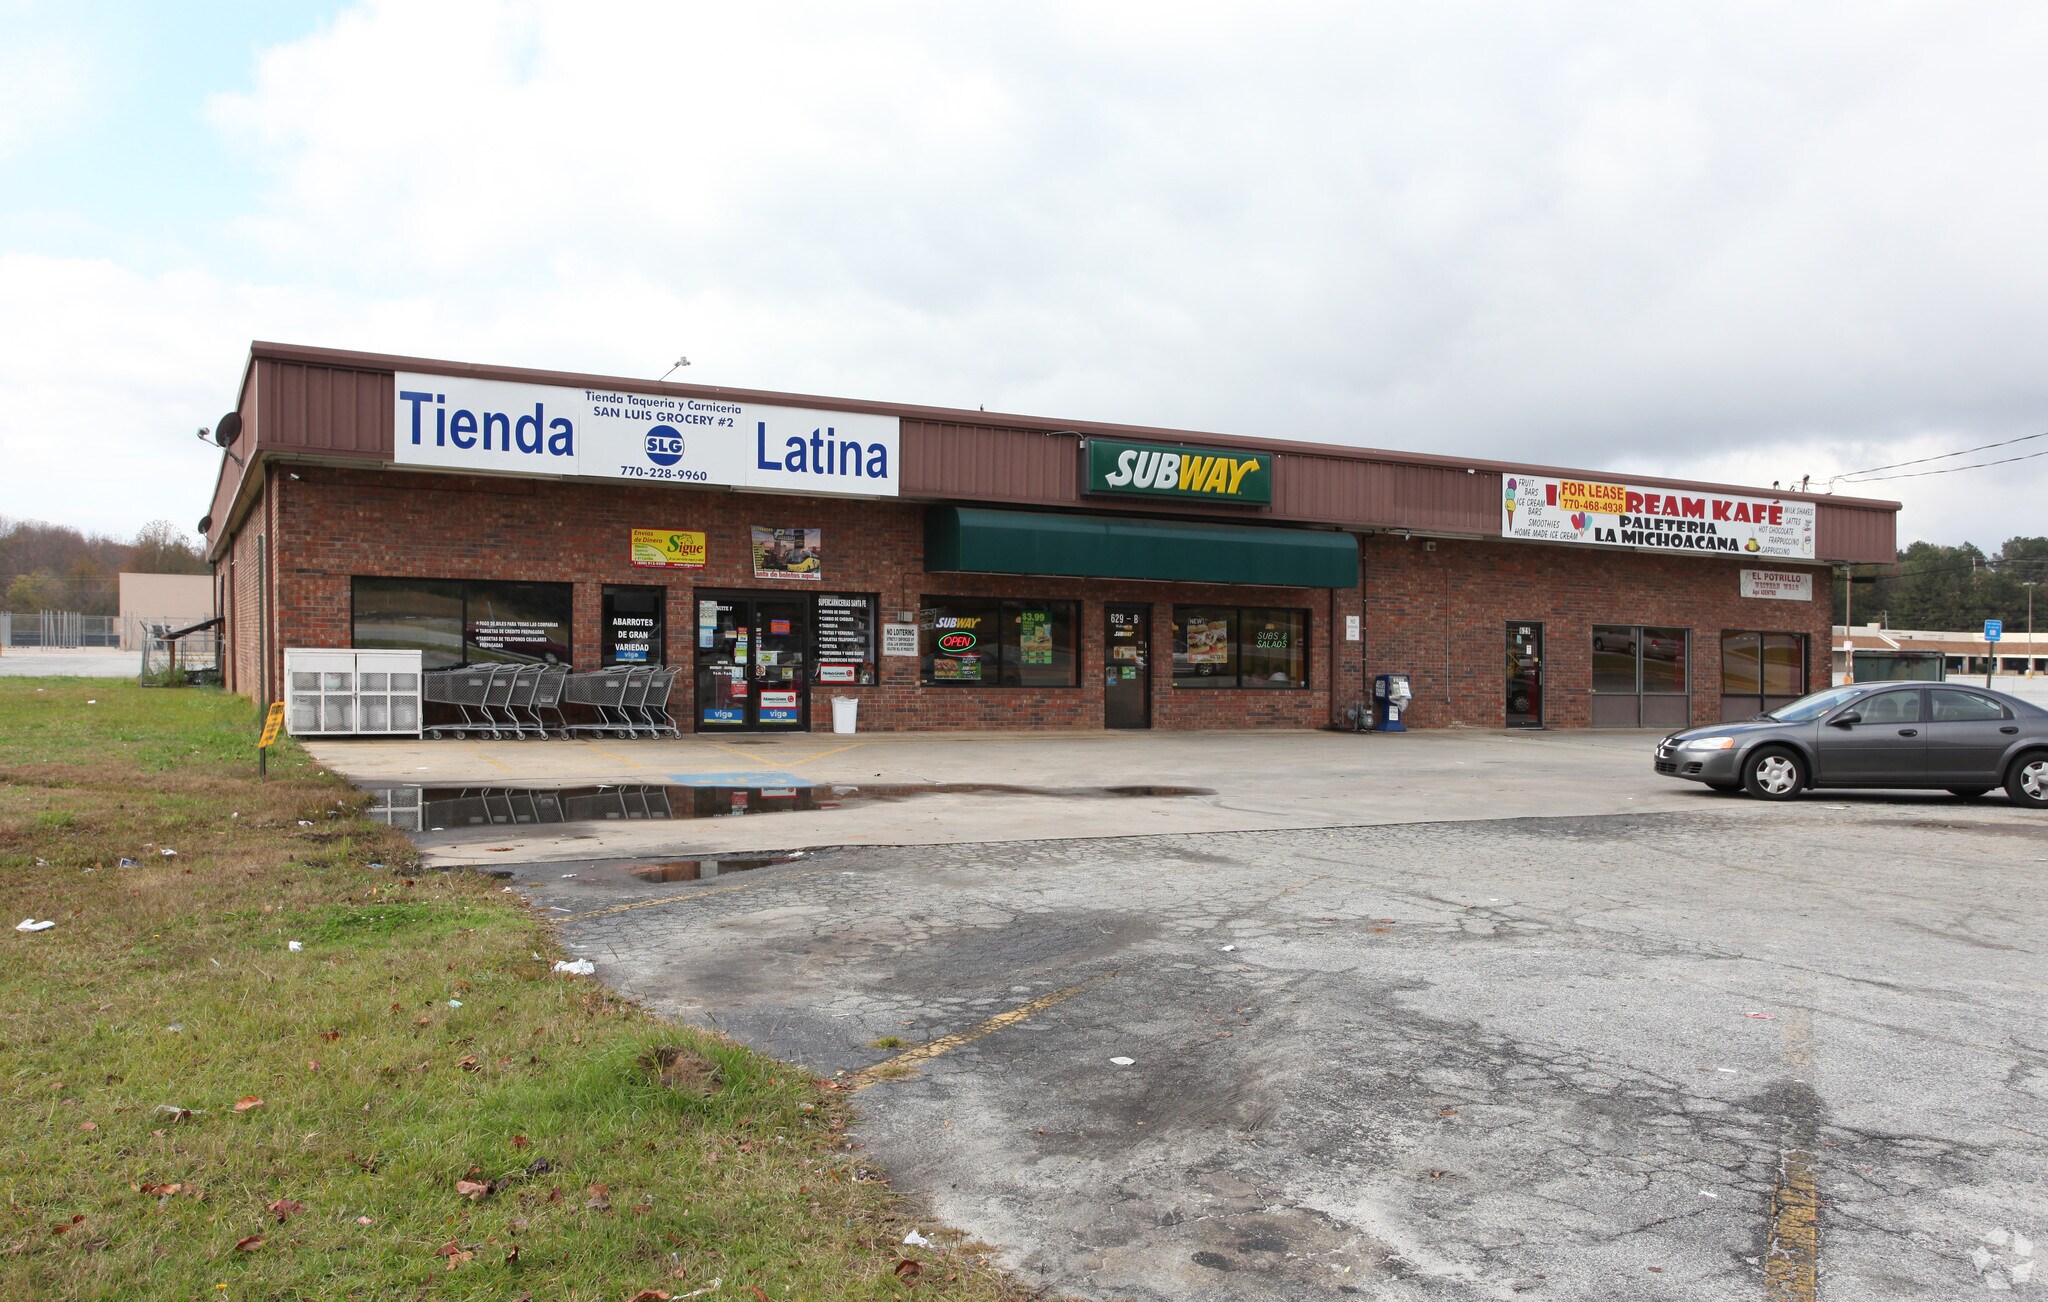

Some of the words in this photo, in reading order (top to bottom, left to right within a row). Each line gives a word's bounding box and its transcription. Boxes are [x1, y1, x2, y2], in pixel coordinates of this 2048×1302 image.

[585, 390, 624, 404] Tienda
[627, 394, 675, 409] Taqueria
[678, 401, 685, 412] y
[687, 400, 742, 414] Carniceria
[593, 406, 620, 418] SAN
[625, 409, 652, 421] LUIS
[656, 411, 714, 426] GROCERY
[717, 417, 734, 428] #2
[399, 390, 575, 457] Tienda
[647, 437, 683, 453] SLG
[757, 421, 888, 480] Latina
[620, 465, 708, 481] 770-228-9960
[1105, 449, 1260, 494] SUBWAY
[1518, 478, 1534, 488] FRUIT
[1524, 487, 1539, 496] BARS
[1562, 482, 1585, 497] FOR
[1589, 485, 1624, 501] LEASE
[1516, 498, 1525, 506] ICE
[1526, 499, 1545, 507] CREAM
[1563, 498, 1623, 513] 770-468-4938
[1528, 508, 1542, 516] BARS
[1625, 491, 1705, 520] REAM
[1712, 499, 1783, 526] KAFÉ
[1784, 507, 1795, 515] MILK
[1796, 507, 1814, 516] SHAKES
[1528, 518, 1560, 528] SMOOTHIES
[1619, 515, 1717, 535] PALETERIA
[1786, 517, 1801, 526] LATTES
[1514, 528, 1530, 537] HOME
[1532, 530, 1548, 538] MADE
[1549, 531, 1558, 539] ICE
[1559, 531, 1578, 540] CREAM
[1759, 526, 1768, 534] HOT
[1769, 526, 1794, 536] CHOCOLATE
[1594, 527, 1617, 543] LA
[1621, 529, 1739, 552] MICHOACANA
[1768, 536, 1799, 546] FRAPPUCCINO
[667, 534, 704, 557] Sigue
[1761, 546, 1791, 556] CAPPUCCINO
[1752, 572, 1761, 580] EL
[1764, 573, 1801, 583] POTRILLO
[851, 599, 862, 608] SANTA
[862, 599, 867, 608] FE
[612, 617, 654, 627] ABARROTES
[1022, 612, 1045, 622] $3.99
[1110, 613, 1124, 624] 629
[1133, 614, 1139, 624] B
[936, 617, 981, 628] SUBWAY
[618, 631, 628, 639] DE
[629, 631, 648, 639] GRAN
[886, 628, 892, 636] NO
[893, 628, 915, 636] LOITERING
[1256, 631, 1279, 640] SUBS
[943, 636, 971, 647] OPEN
[1256, 640, 1288, 648] SALADS
[615, 643, 649, 651] VARIEDAD
[714, 709, 733, 719] vigo
[769, 709, 788, 719] vigo
